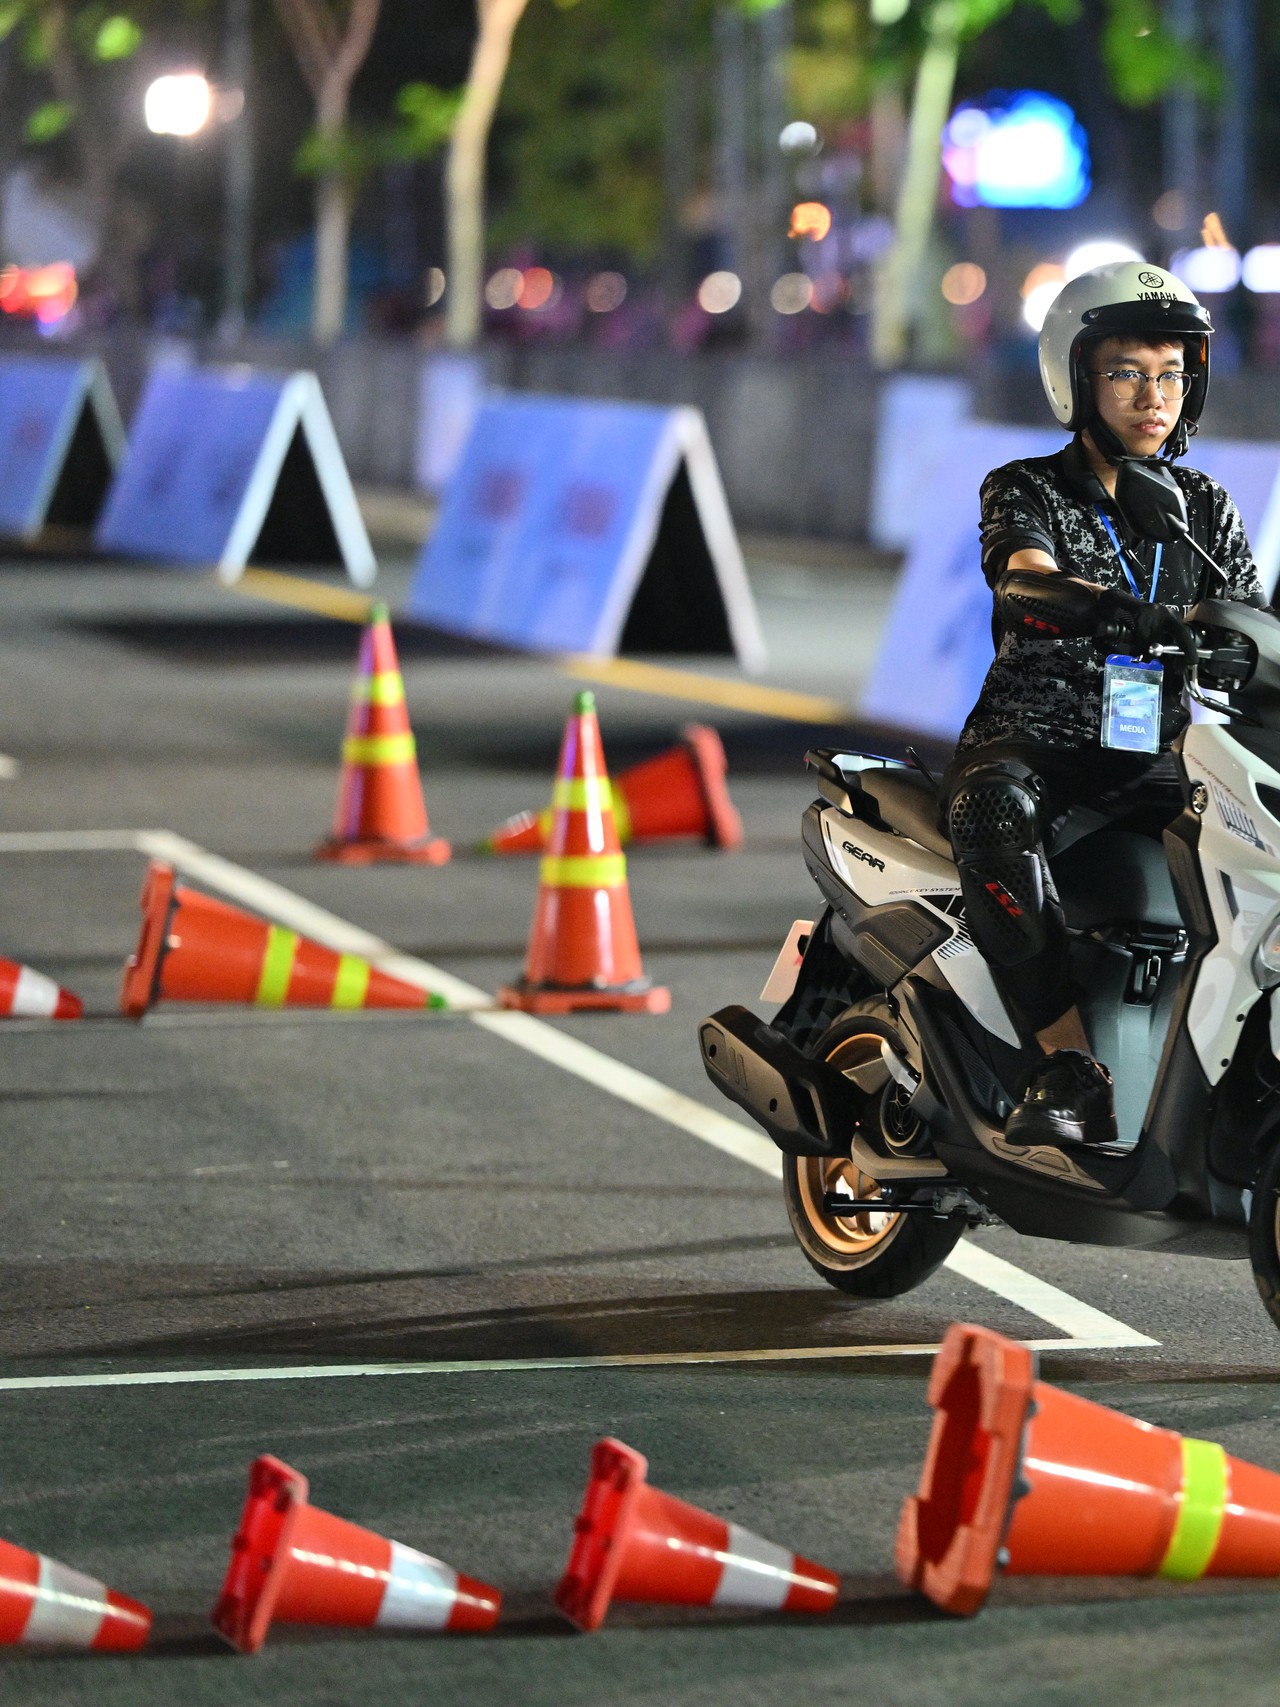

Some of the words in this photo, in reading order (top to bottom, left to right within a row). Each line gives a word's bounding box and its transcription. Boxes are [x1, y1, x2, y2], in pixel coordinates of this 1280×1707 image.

[1137, 291, 1178, 302] YAMAHA
[1119, 723, 1146, 735] MEDIA
[842, 840, 885, 873] GEAR
